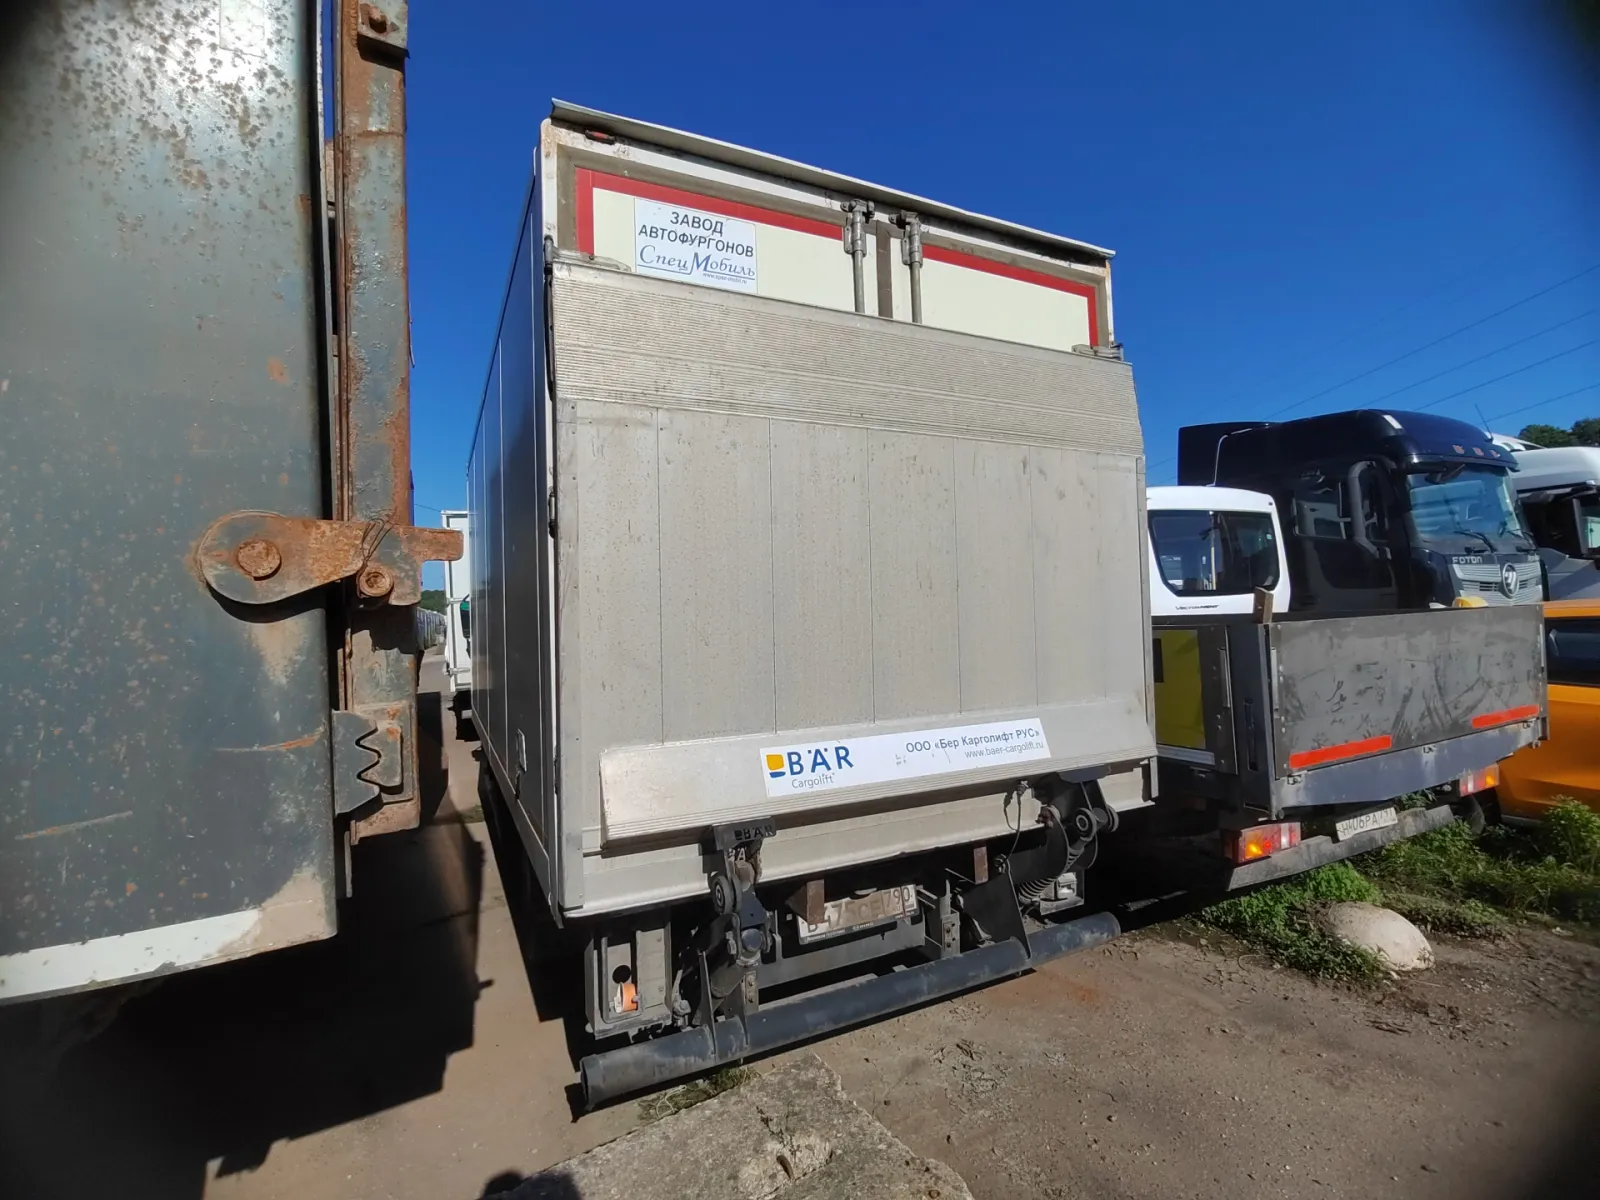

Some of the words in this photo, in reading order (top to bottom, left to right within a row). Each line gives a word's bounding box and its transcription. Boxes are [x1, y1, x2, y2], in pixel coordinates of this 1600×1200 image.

[670, 211, 724, 237] ЗАВОД
[638, 224, 754, 258] АВТОФУРГОНОВ
[905, 740, 931, 753] ООО
[934, 738, 960, 750] «Бер
[961, 730, 1014, 747] Карголифт
[1015, 727, 1040, 740] РУС»
[964, 741, 1045, 760] www.baer-cargolift.ru
[786, 745, 854, 776] BÄR
[791, 773, 834, 789] Cargolift
[882, 886, 911, 908] 790
